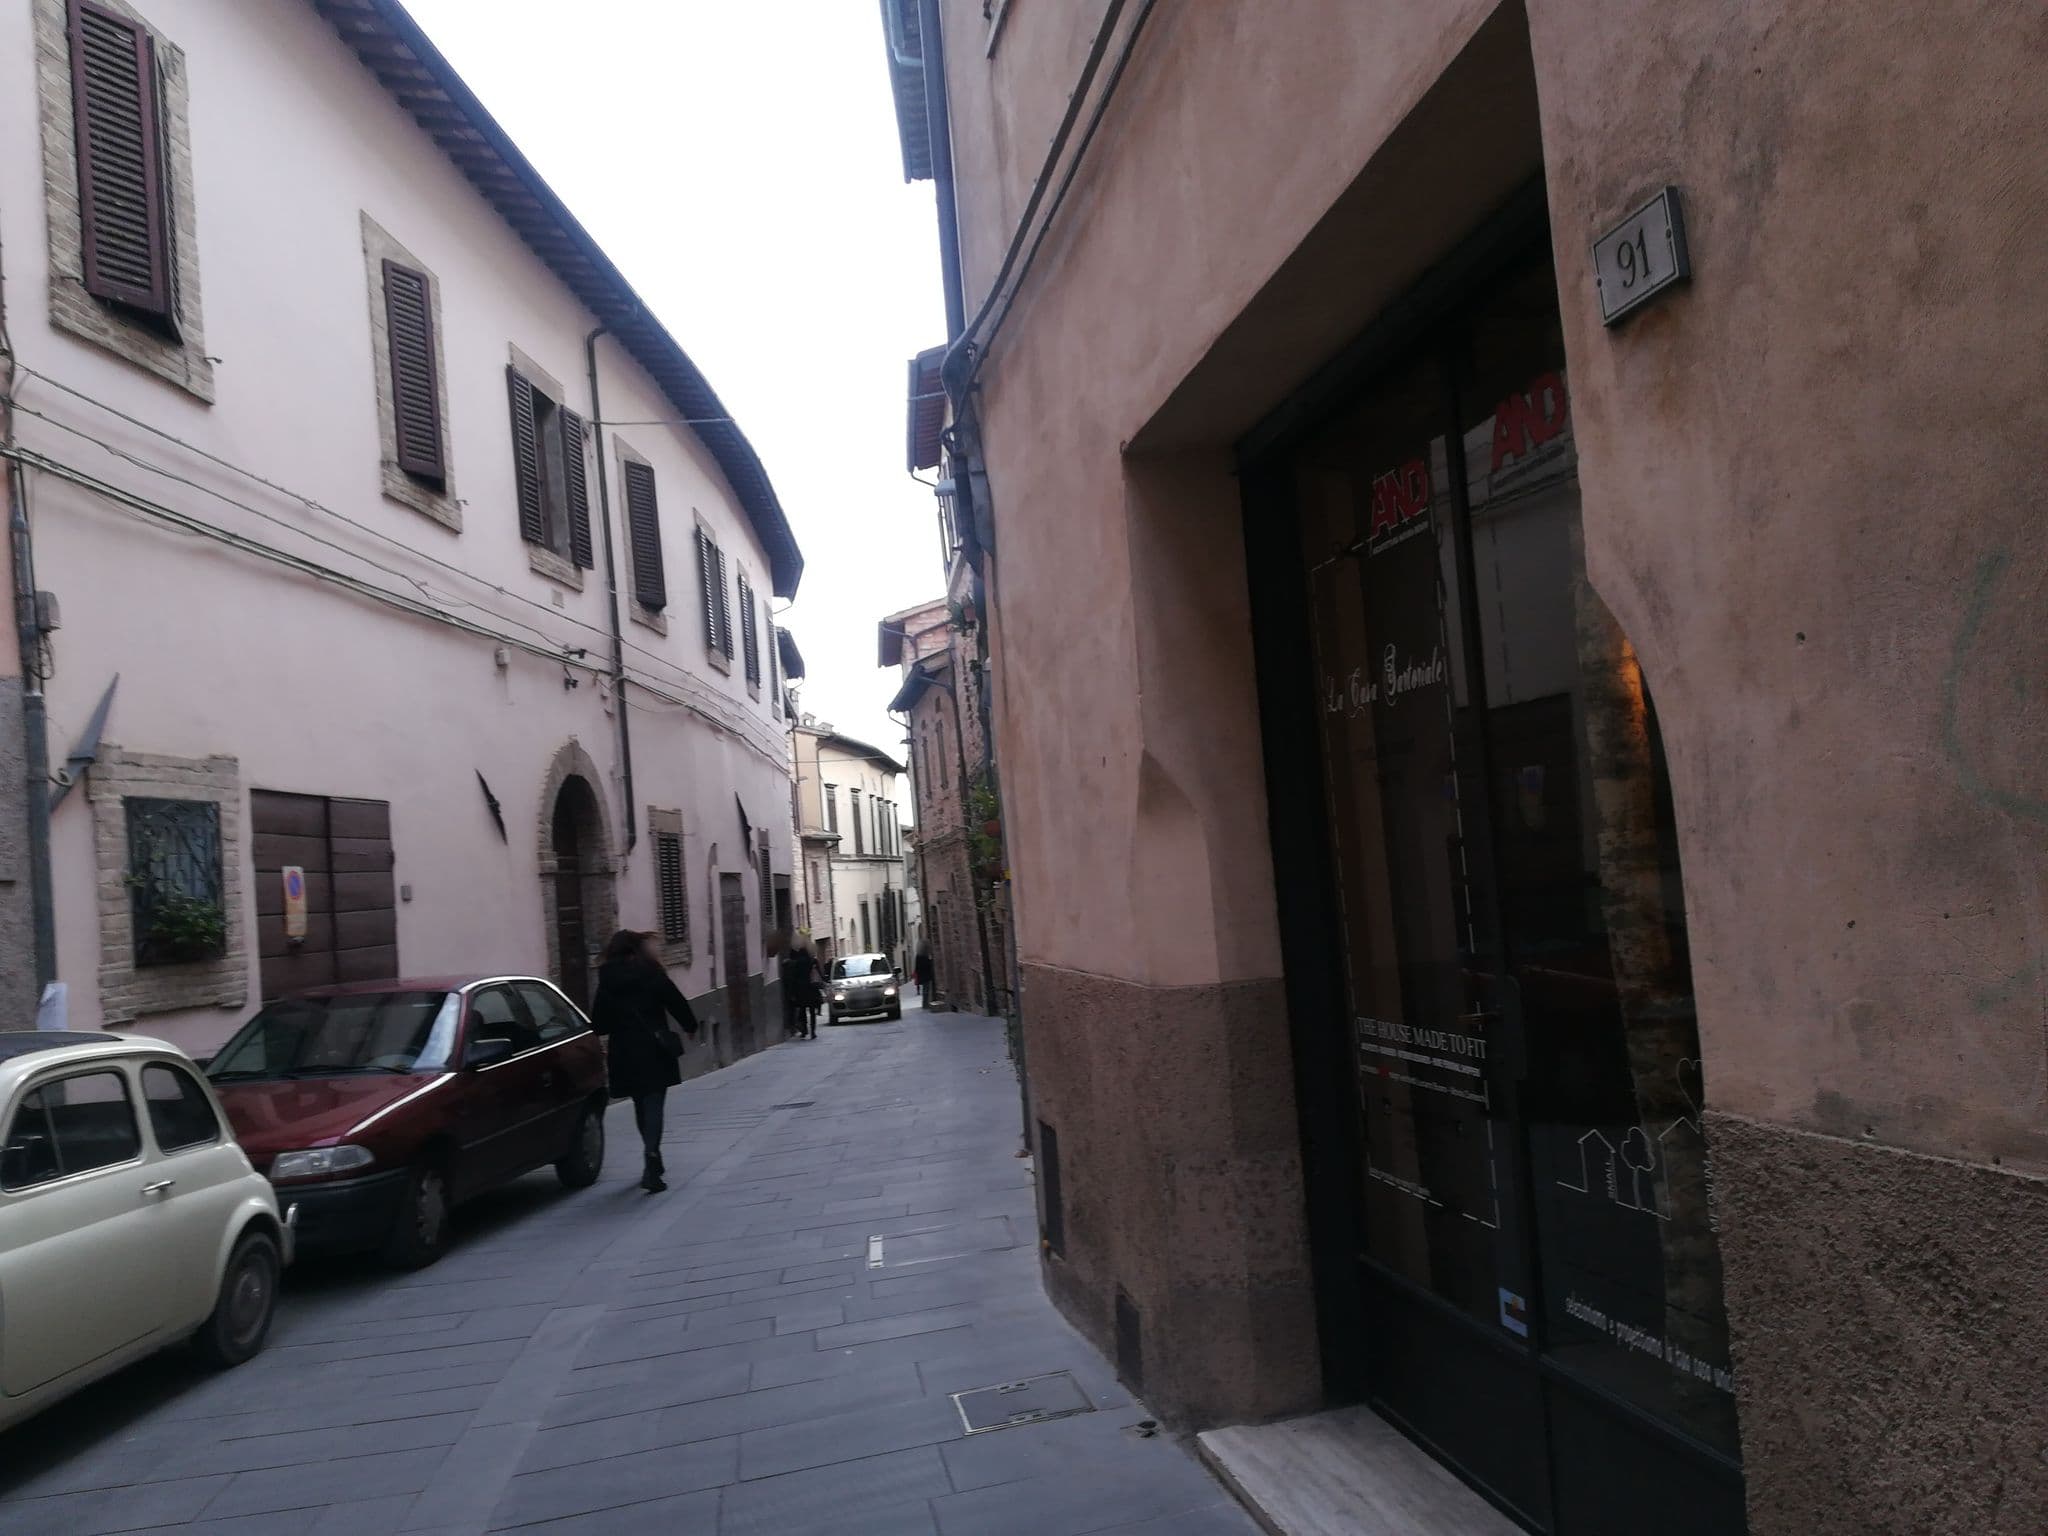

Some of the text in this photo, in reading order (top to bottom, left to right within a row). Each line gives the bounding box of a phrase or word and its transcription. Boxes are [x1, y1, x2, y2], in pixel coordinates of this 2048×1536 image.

[1617, 226, 1652, 289] 91
[1357, 1016, 1487, 1059] THE HOUSE MADE TO FIT
